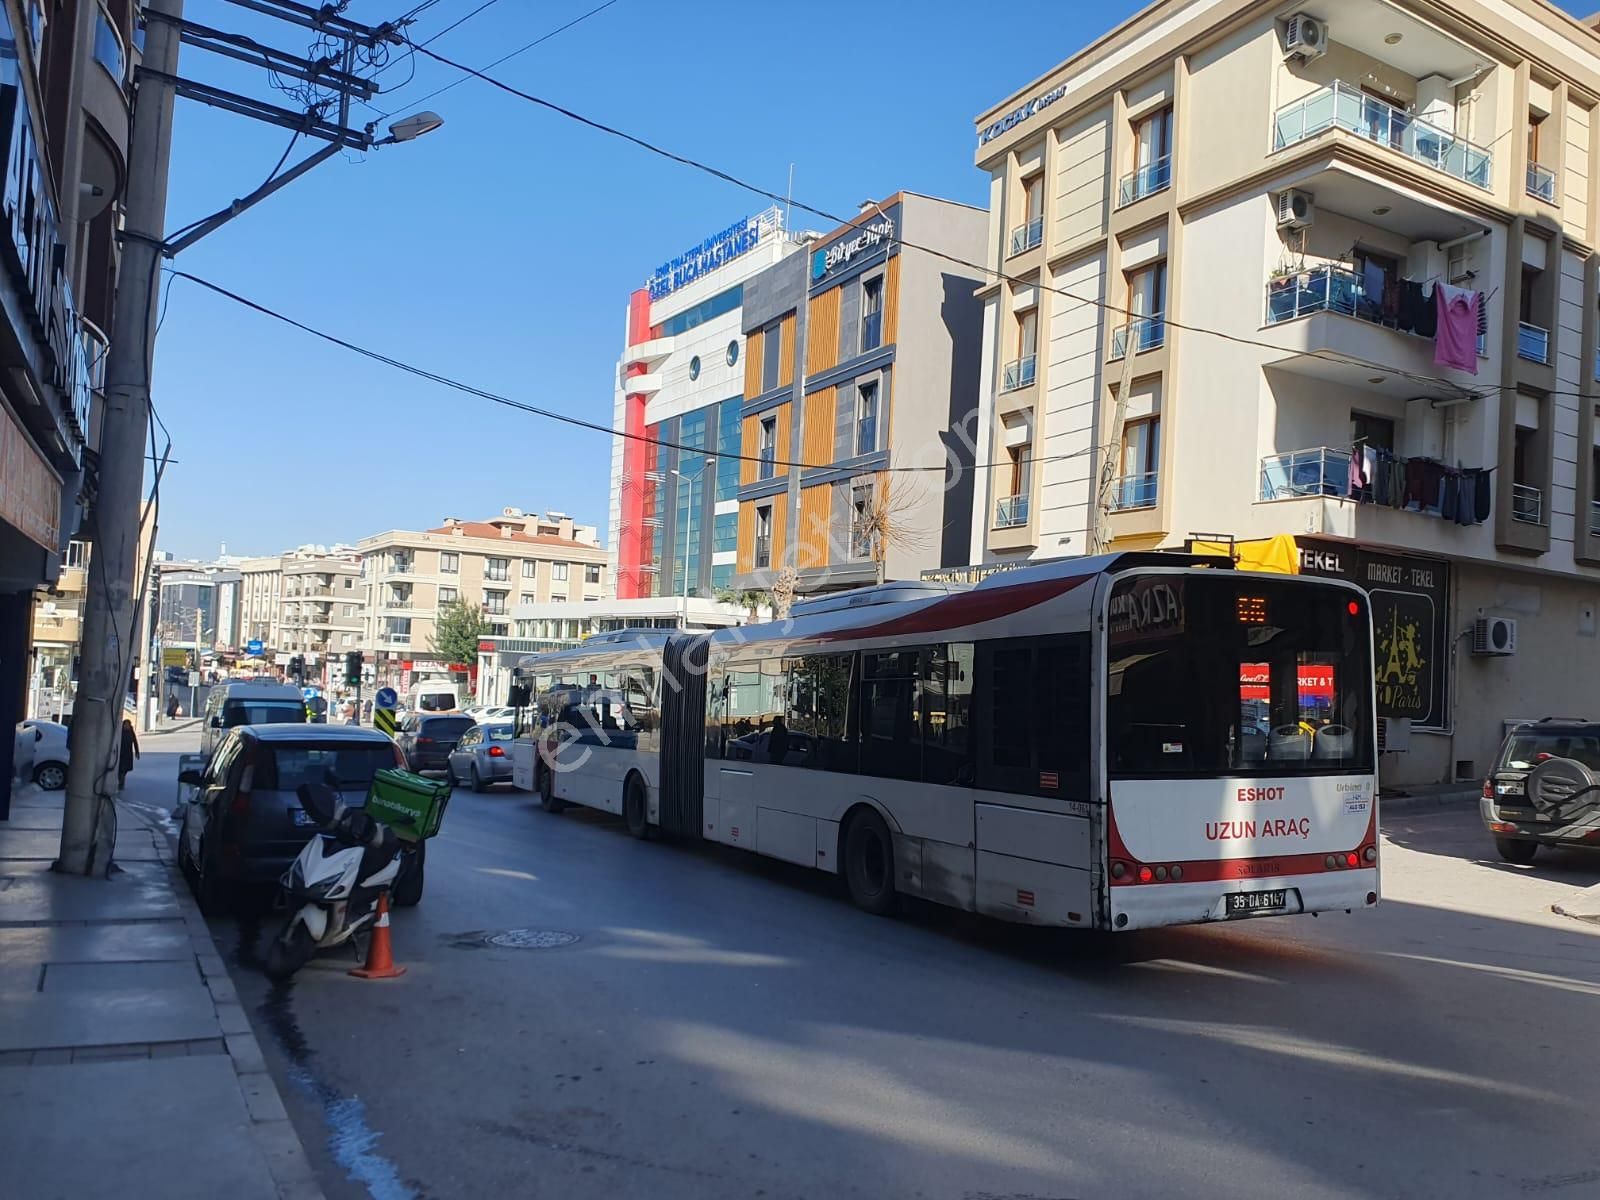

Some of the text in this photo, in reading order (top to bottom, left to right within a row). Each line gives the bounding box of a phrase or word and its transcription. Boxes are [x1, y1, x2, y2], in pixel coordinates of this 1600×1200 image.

[673, 260, 700, 290] BUCA
[700, 220, 760, 277] HASTANESİ
[1367, 562, 1402, 584] MARKET
[1411, 568, 1435, 588] TEKEL
[1319, 677, 1326, 687] &
[1237, 787, 1285, 801] ESHOT
[1206, 818, 1310, 840] UZUN ARAÇ
[1233, 895, 1245, 909] 35
[1263, 891, 1285, 907] 6147
